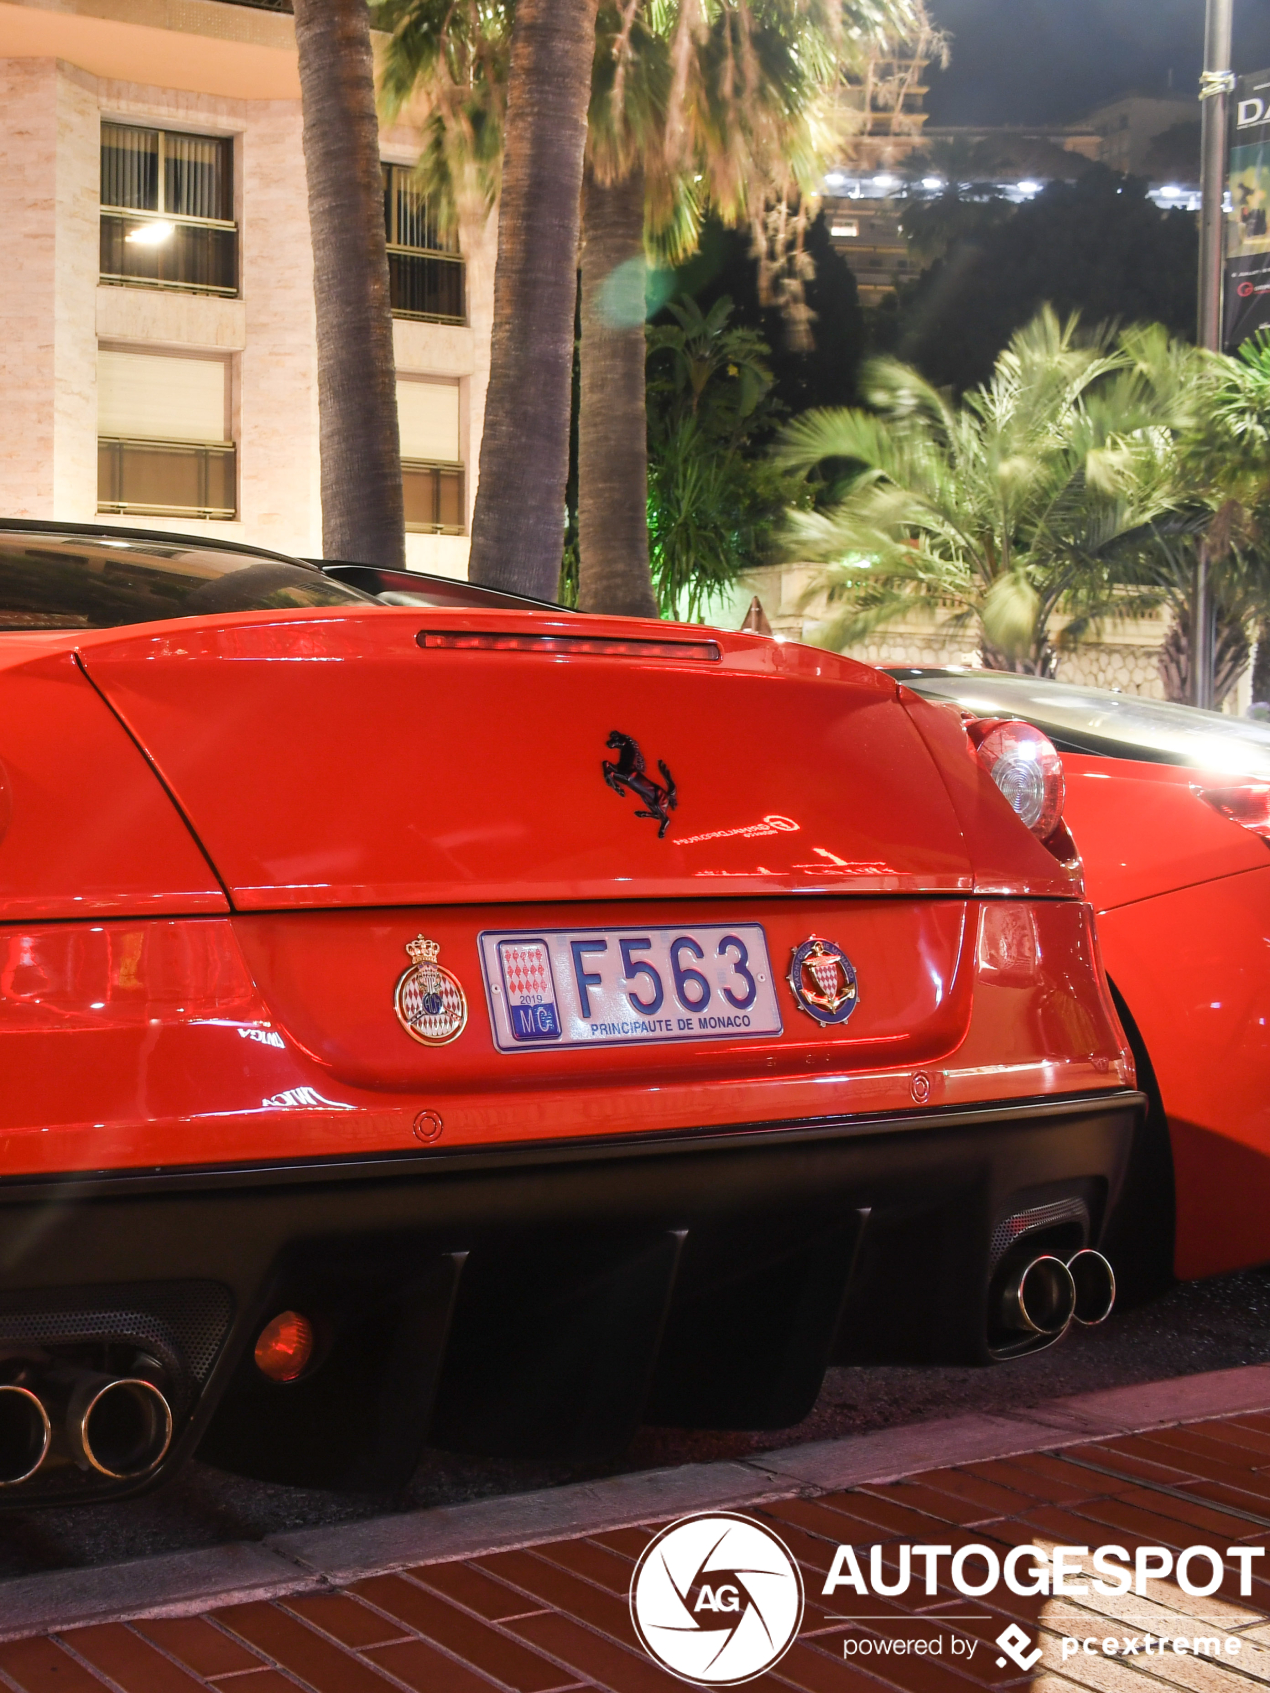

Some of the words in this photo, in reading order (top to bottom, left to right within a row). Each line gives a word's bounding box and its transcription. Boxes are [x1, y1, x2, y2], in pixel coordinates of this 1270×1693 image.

[1237, 97, 1270, 126] D
[570, 935, 757, 1019] F563
[519, 994, 543, 1005] 2019
[519, 1008, 550, 1033] MC
[590, 1019, 674, 1036] PRINCIPAUTE
[677, 1018, 695, 1031] DE
[698, 1014, 751, 1030] MONACO
